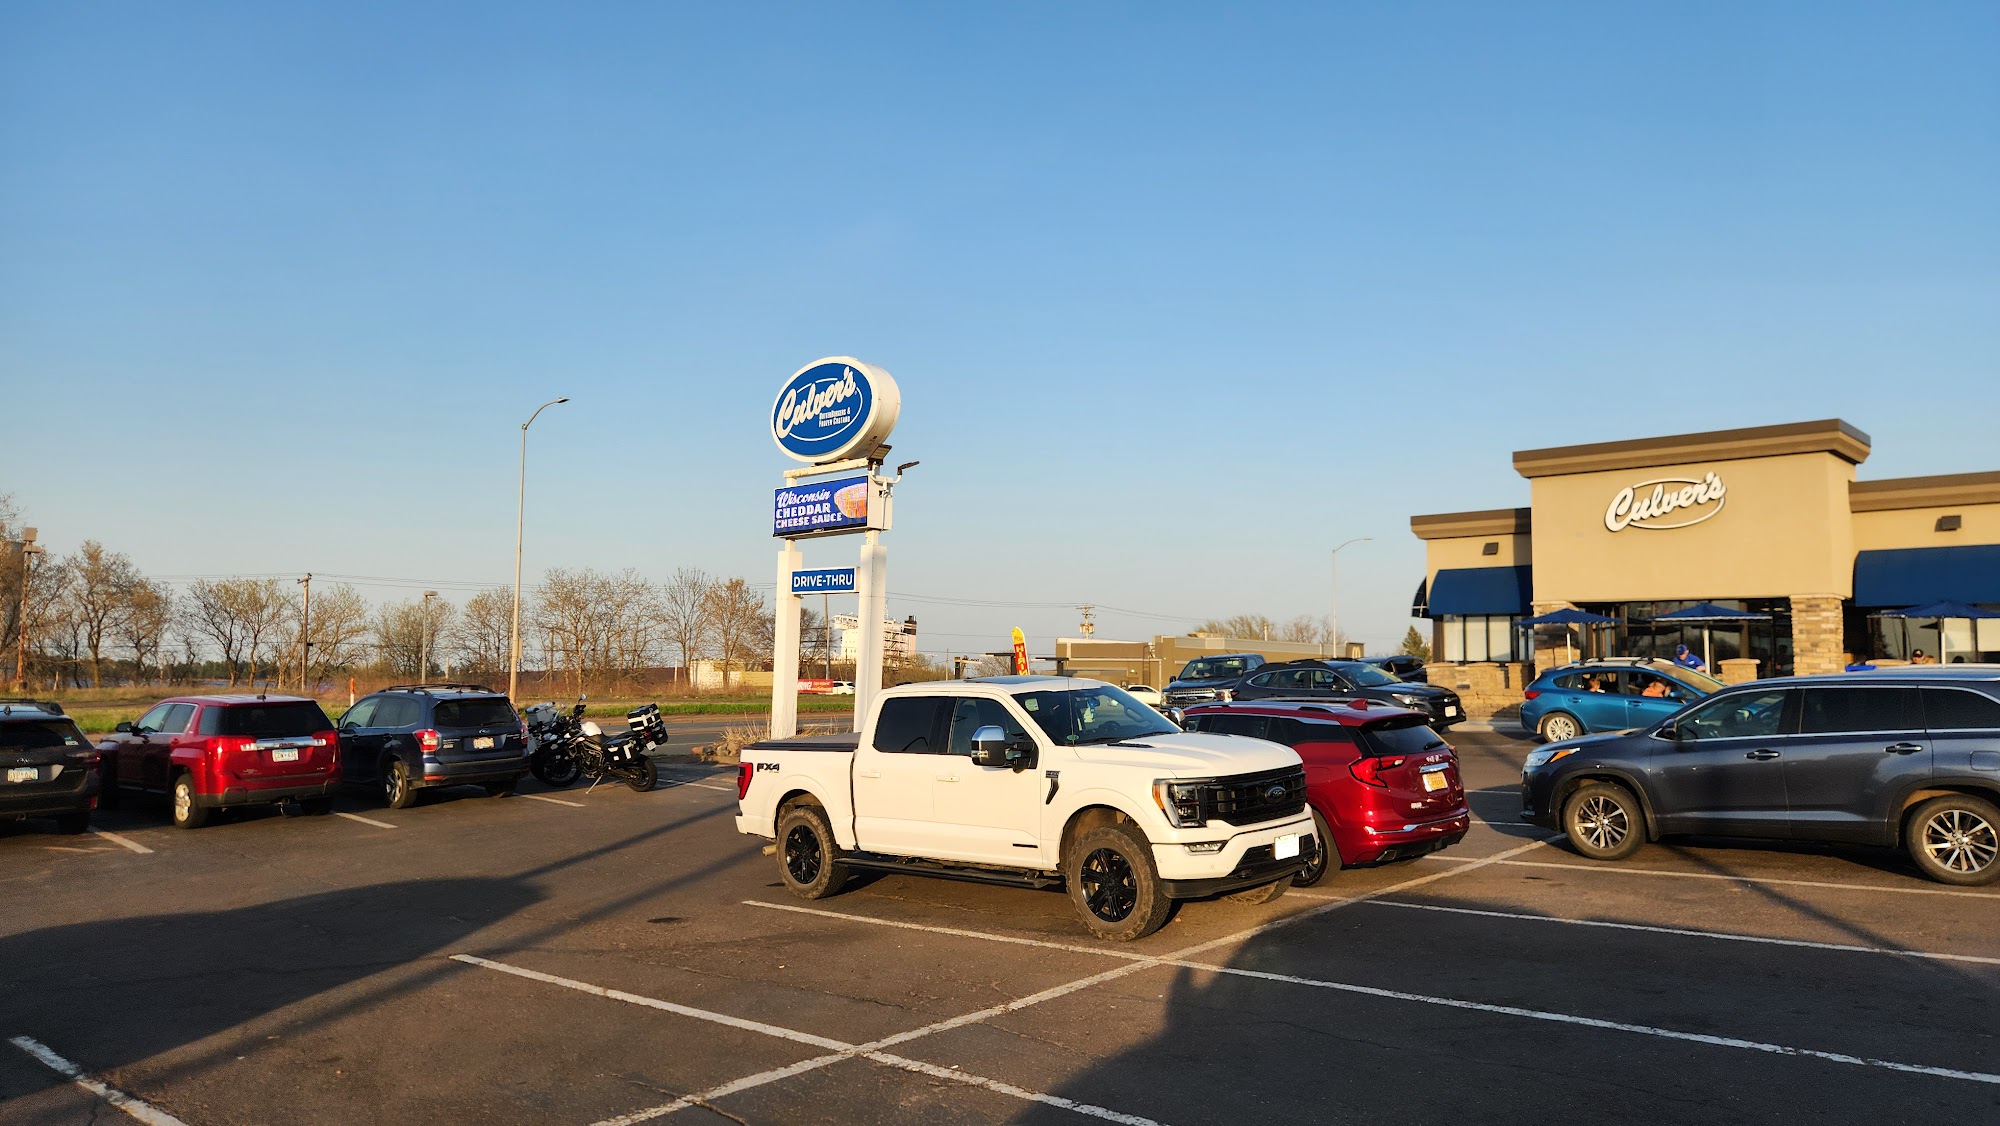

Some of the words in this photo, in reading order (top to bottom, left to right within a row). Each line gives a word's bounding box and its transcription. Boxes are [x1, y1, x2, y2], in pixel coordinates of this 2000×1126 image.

[776, 366, 856, 438] Culver's
[777, 489, 831, 508] Wisconsin
[1605, 471, 1727, 531] Culver's
[776, 503, 831, 519] CHEDDAR
[776, 516, 810, 528] CHEESE
[812, 513, 843, 524] SAUCE
[795, 574, 852, 588] DRIVE-THRU
[1016, 645, 1028, 676] HIRIN
[757, 762, 780, 773] FX4
